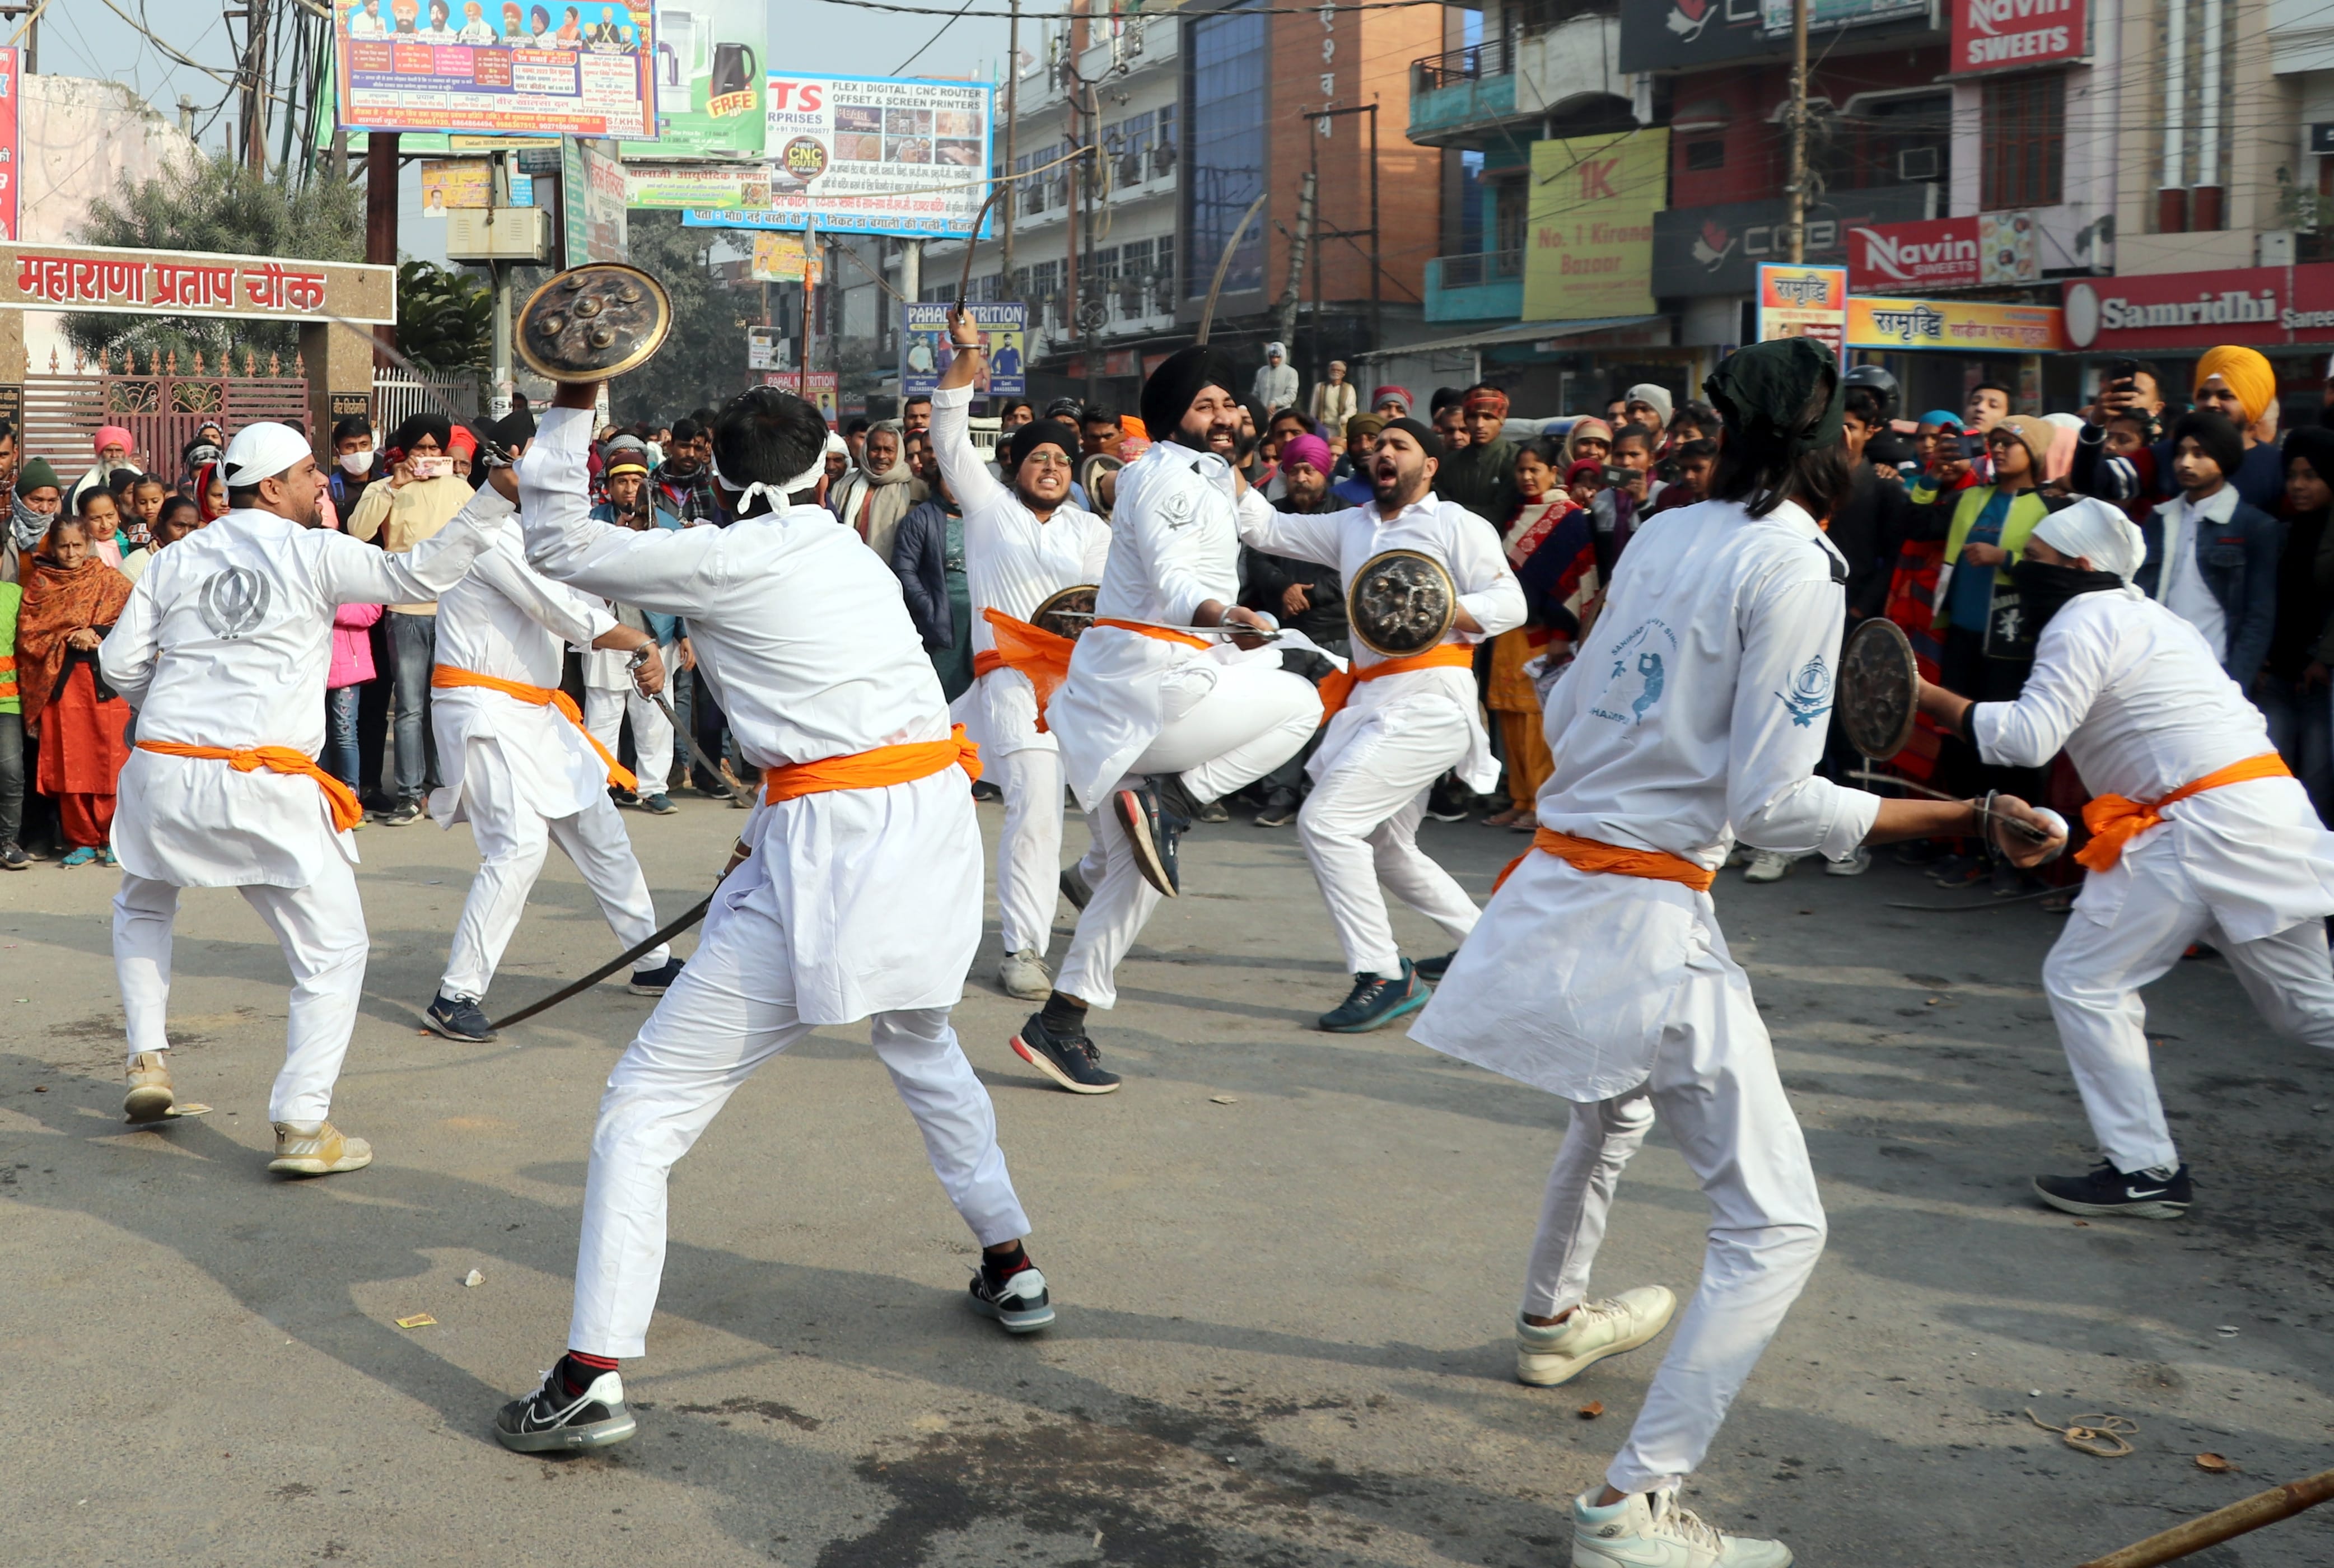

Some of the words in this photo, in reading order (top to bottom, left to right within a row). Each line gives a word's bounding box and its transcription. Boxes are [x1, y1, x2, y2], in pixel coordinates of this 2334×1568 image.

[1968, 25, 2069, 64] SWEETS
[832, 82, 858, 92] FLEX
[866, 83, 907, 95] DIGITAL
[916, 87, 937, 96] CNC
[940, 88, 981, 98] ROUTER
[711, 94, 752, 116] FREE
[833, 94, 872, 104] OFFSET
[875, 96, 883, 105] &
[886, 97, 927, 107] SCREEN
[930, 100, 981, 110] PRINTERS
[837, 106, 872, 122] PEARL
[539, 123, 578, 131] 9027109650
[788, 148, 822, 160] CNC
[788, 159, 821, 167] ROUTER
[694, 209, 712, 220] पता
[746, 211, 761, 224] नई
[764, 211, 788, 225] बस्ती
[827, 214, 852, 227] निकट
[869, 214, 900, 230] बंगाली
[903, 217, 917, 230] की
[920, 217, 944, 232] गली,
[1538, 226, 1569, 248] No.
[1576, 223, 1583, 246] 1
[1591, 222, 1652, 245] Kirana
[1850, 227, 1977, 280] Navin
[1561, 253, 1622, 275] Bazaar
[1914, 260, 1977, 276] SWEETS
[17, 255, 150, 304] महाराणा
[152, 263, 238, 309] प्रताप
[243, 263, 327, 311] चौक
[1773, 273, 1829, 307] समृद्धि
[908, 306, 948, 323] PAHAL
[970, 306, 1023, 323] TRITION
[2101, 288, 2277, 330] Samridhi
[1871, 304, 1944, 343] समृद्धि
[1991, 326, 2015, 340] एण्ड
[768, 376, 793, 387] PAHAL
[795, 376, 835, 388] NTRITION
[333, 398, 343, 415] वीर
[344, 398, 367, 414] शिरोमणि
